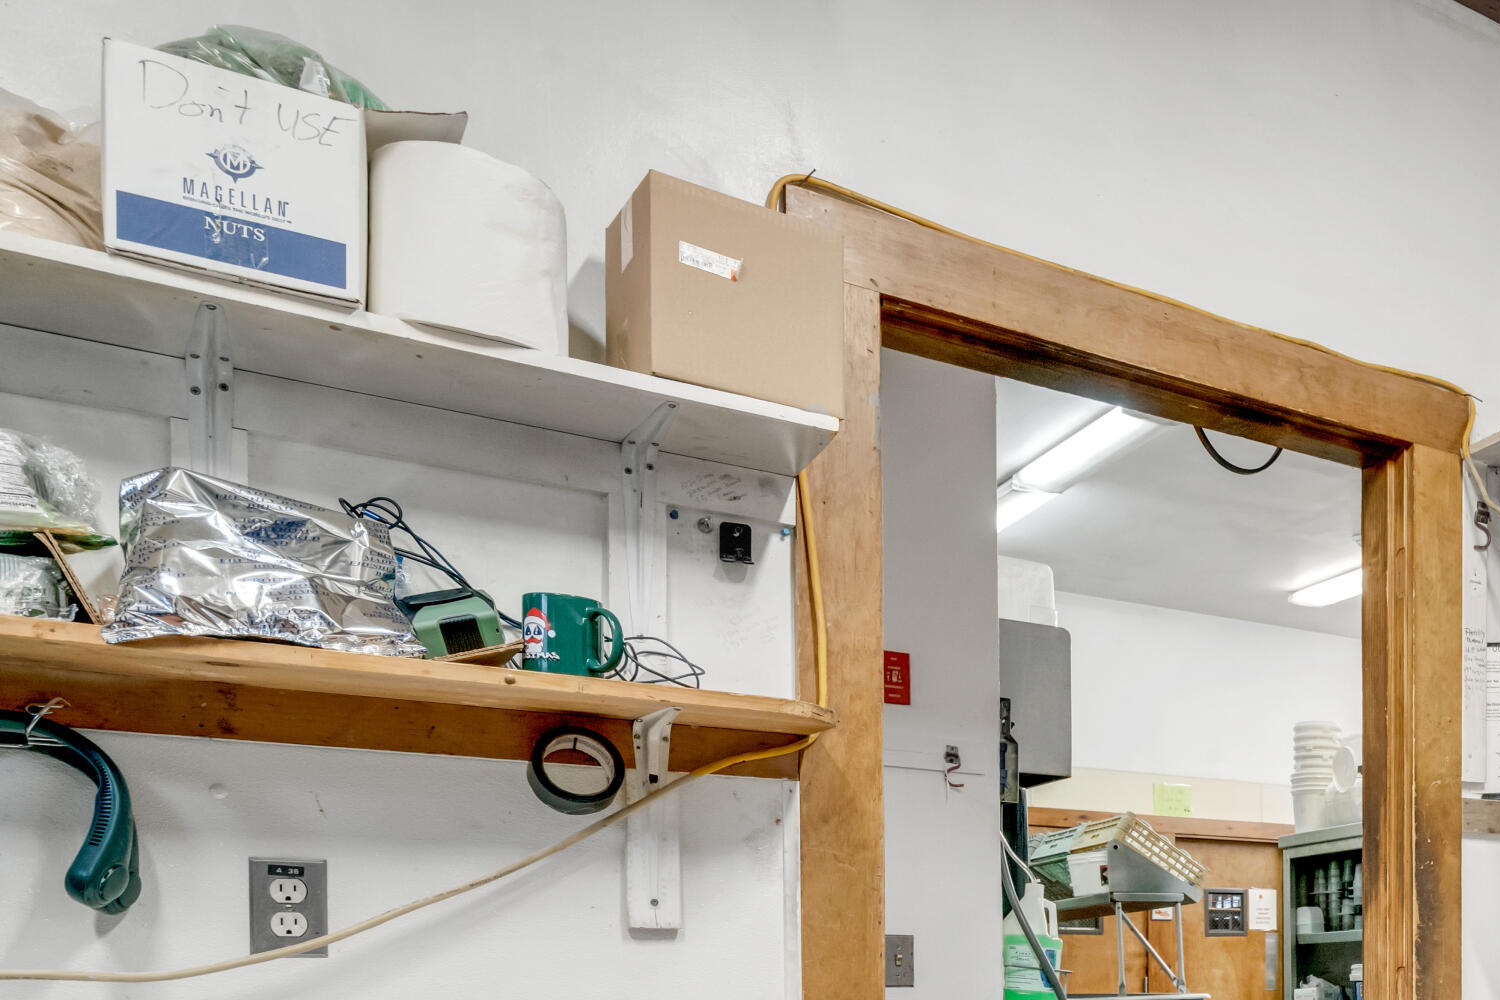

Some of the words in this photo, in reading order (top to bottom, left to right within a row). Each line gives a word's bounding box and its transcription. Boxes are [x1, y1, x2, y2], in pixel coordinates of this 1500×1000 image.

[277, 103, 358, 147] USE
[183, 177, 287, 217] MAGELLAN
[204, 216, 265, 241] NUTS
